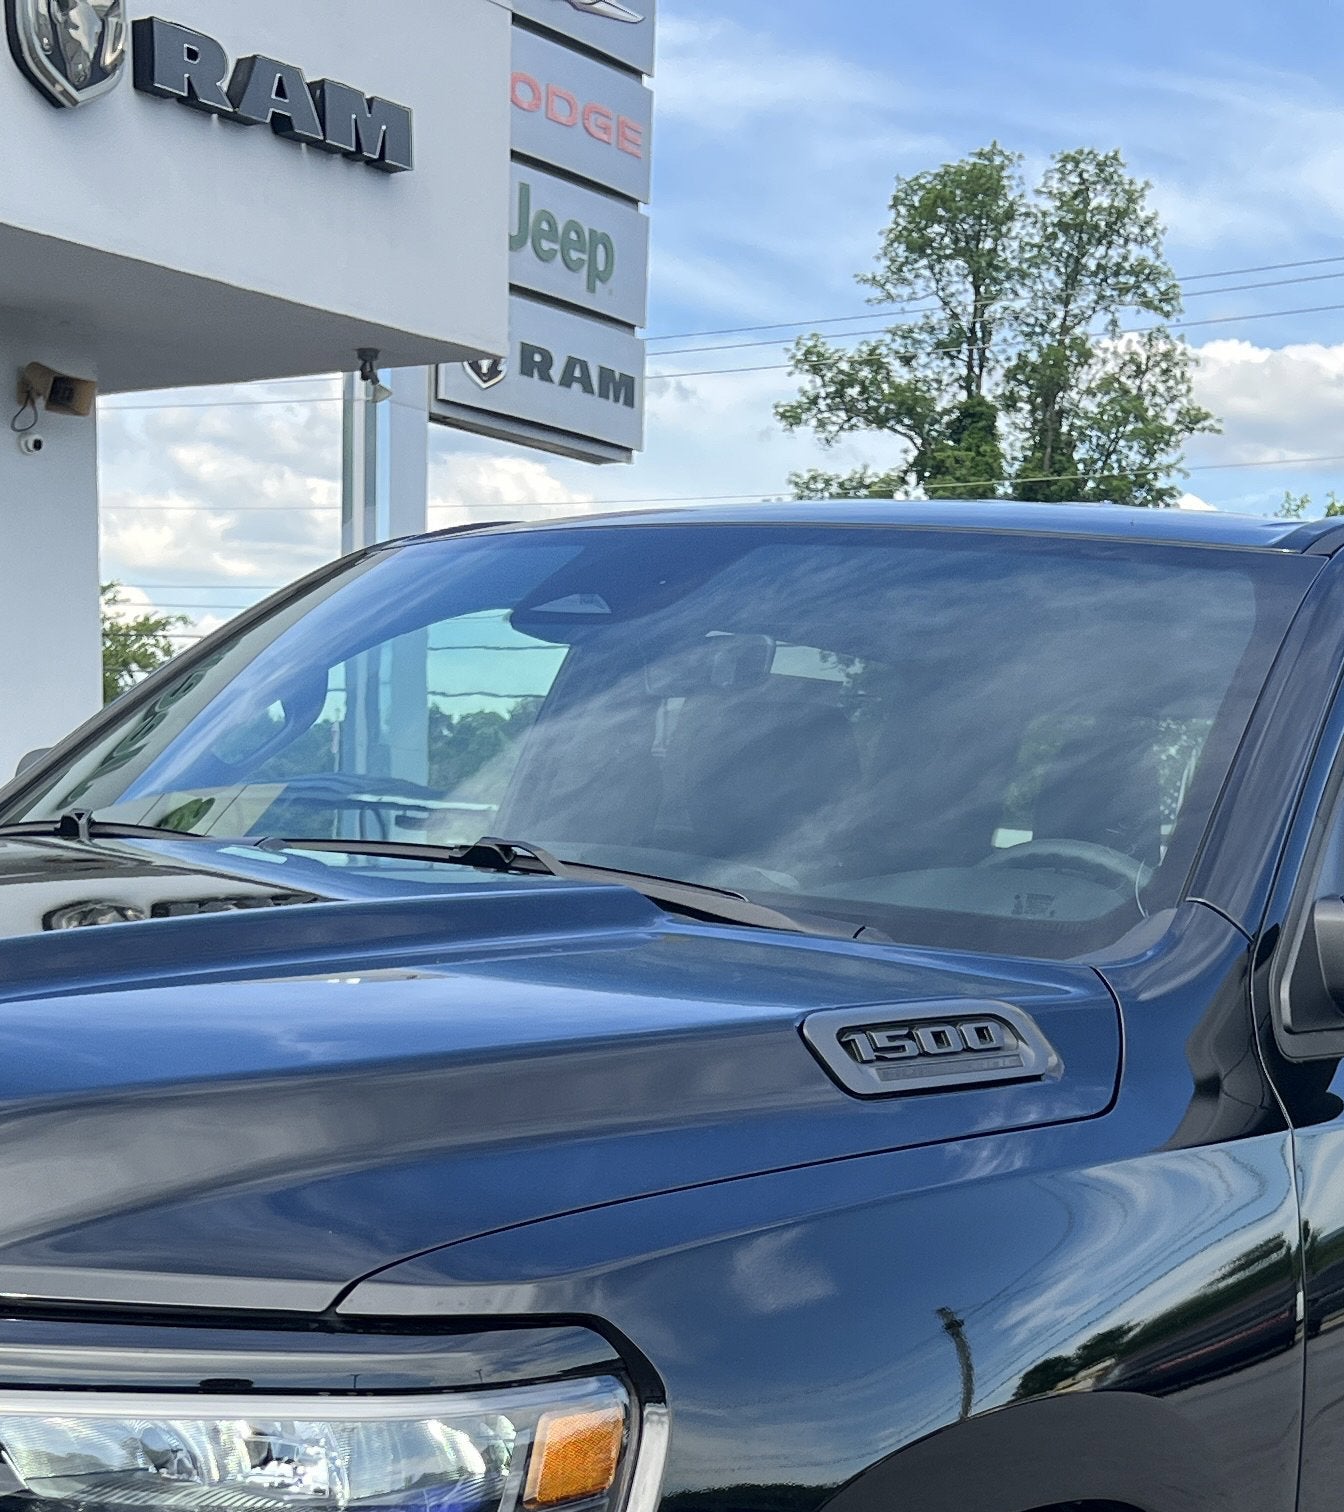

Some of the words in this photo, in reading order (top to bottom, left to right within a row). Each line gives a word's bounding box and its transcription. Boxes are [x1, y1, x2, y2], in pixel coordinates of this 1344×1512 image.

[132, 16, 413, 173] RAM
[510, 71, 643, 159] ODGE
[509, 182, 614, 293] Jeep
[519, 340, 636, 409] RAM
[840, 1020, 1007, 1063] 1500
